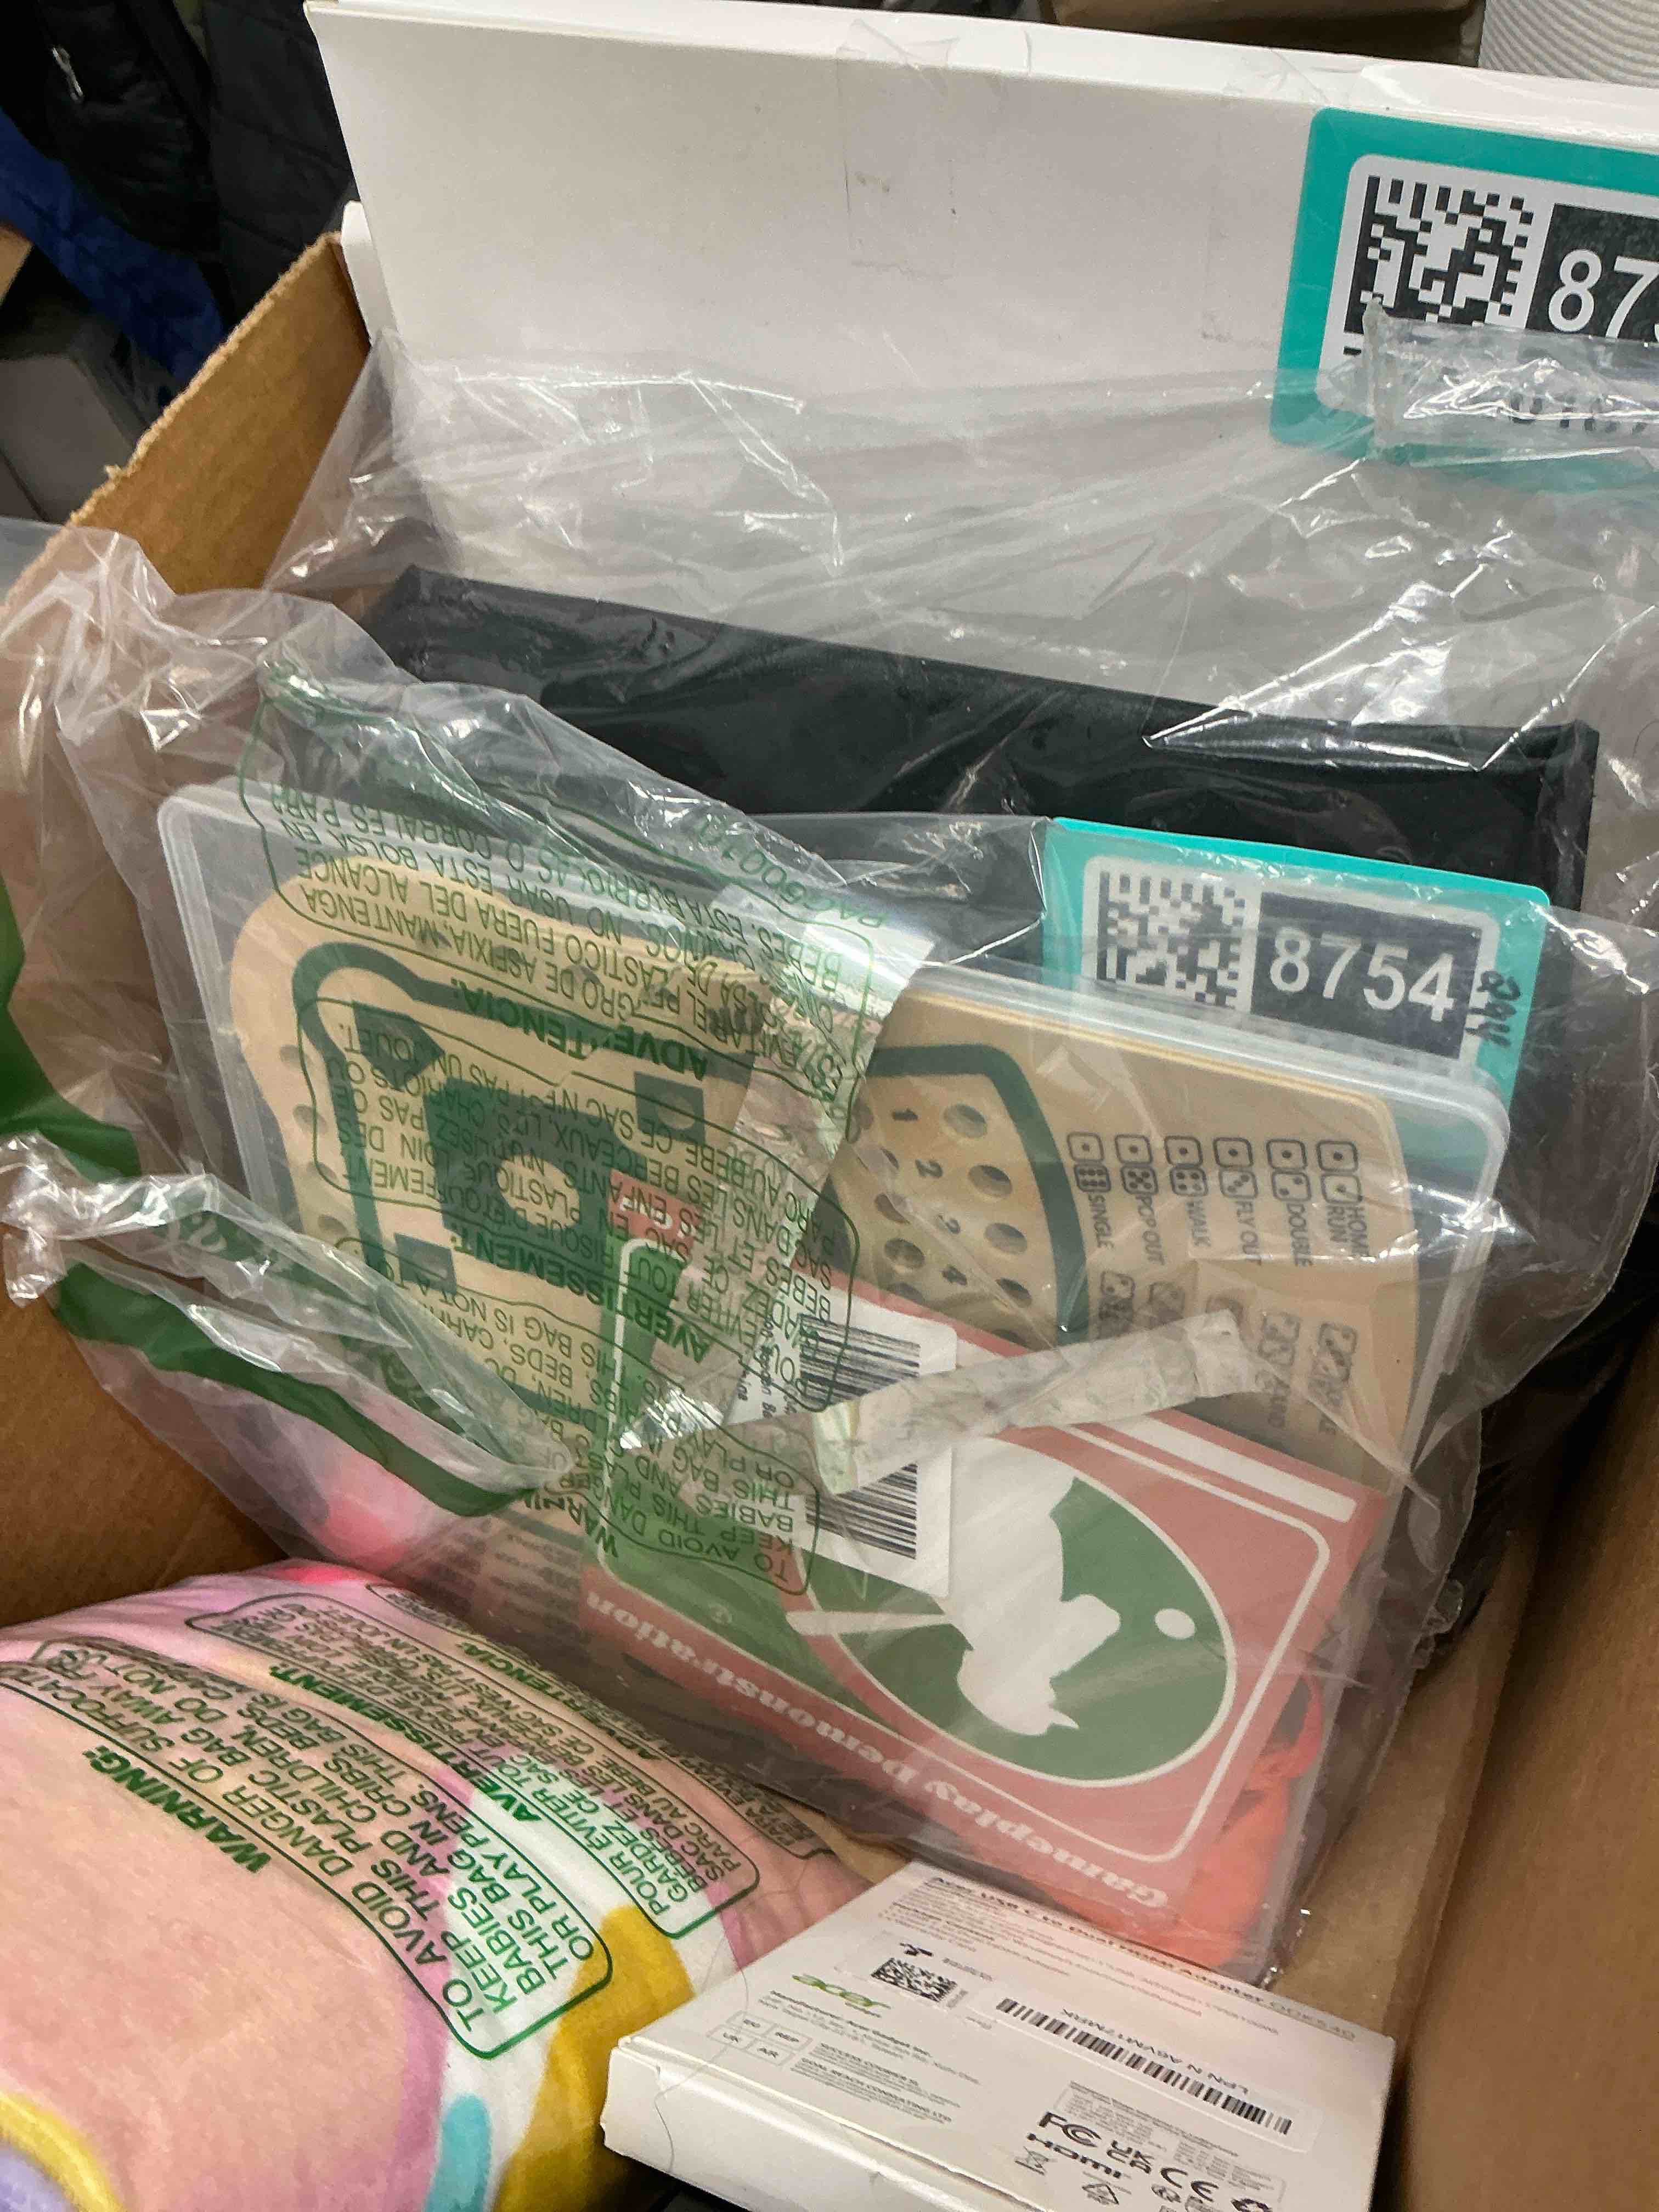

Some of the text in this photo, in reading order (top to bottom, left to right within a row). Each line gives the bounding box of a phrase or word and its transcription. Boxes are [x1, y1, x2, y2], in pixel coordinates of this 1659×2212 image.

[1549, 249, 1659, 341] 87
[350, 804, 492, 860] CORRALES
[280, 819, 621, 944] NO USAR ESTA BOLSA EN
[295, 847, 409, 905] ALCANCE
[300, 884, 439, 949] MANTENGA
[419, 881, 467, 923] DEL
[473, 898, 554, 956] FUERA
[442, 921, 537, 984] ASFIXIA,
[545, 961, 574, 1000] DE
[1269, 927, 1454, 1023] 8754
[686, 990, 707, 1034] EL
[325, 1057, 366, 1087] OU
[434, 1053, 462, 1080] UN
[469, 1063, 510, 1101] PAS
[331, 1084, 368, 1115] CE
[378, 1094, 424, 1131] PAS
[586, 1098, 634, 1141] SAC
[337, 1119, 384, 1154] DES
[548, 1116, 679, 1197] BERCEAUX,
[639, 1118, 673, 1154] CE
[915, 1159, 944, 1178] 2
[463, 1161, 580, 1229] PLASTIQUE
[686, 1175, 728, 1221] LES
[1235, 1200, 1255, 1231] FLY
[534, 1212, 615, 1270] RISQUE
[599, 1207, 629, 1242] EN
[678, 1207, 718, 1250] LES
[732, 1197, 791, 1256] DANS
[1089, 1193, 1114, 1249] SINGLE
[1187, 1200, 1212, 1249] WALK
[1286, 1203, 1313, 1268] DOUBLE
[1327, 1205, 1348, 1243] RUN
[645, 1227, 690, 1266] SAC
[725, 1234, 755, 1273] ET
[1142, 1229, 1165, 1266] OUT
[416, 1276, 430, 1296] A
[623, 1254, 679, 1304] TOUT
[702, 1254, 729, 1294] CE
[439, 1288, 486, 1320] NOT
[450, 1236, 712, 1364] AVERTISSEMENT:
[494, 1308, 515, 1336] IS
[523, 1317, 572, 1359] BAG
[503, 1338, 572, 1388] BEDS,
[634, 1455, 680, 1498] AND
[672, 1447, 720, 1492] BAG
[755, 1462, 795, 1488] OR
[652, 1493, 702, 1536] THIS
[696, 1493, 793, 1533] BABIES
[731, 1480, 795, 1513] THIS
[657, 1529, 741, 1561] AVOID
[720, 1526, 793, 1555] KEEP
[753, 1553, 789, 1583] TO
[586, 1591, 917, 1784] Demonstration
[174, 1697, 228, 1724] DO
[281, 1707, 346, 1745] BAG
[516, 1712, 563, 1738] SAC
[179, 1726, 252, 1768] BAG
[268, 1666, 542, 1823] AVERTISSEMENT:
[339, 1742, 407, 1789] THIS
[565, 1736, 594, 1755] CE
[323, 1752, 412, 1818] CRIBS,
[468, 1748, 531, 1787] TOUT
[509, 1754, 560, 1784] SAC
[582, 1763, 627, 1792] LES
[81, 1744, 272, 1875] WARNING:
[247, 1769, 373, 1855] PLASTIC
[409, 1784, 490, 1849] PENS.
[561, 1790, 600, 1814] CE
[602, 1803, 638, 1824] ET
[624, 1793, 683, 1838] DANS
[651, 1797, 686, 1821] AU
[380, 1830, 450, 1878] AND
[408, 1819, 449, 1847] IN
[684, 1821, 741, 1872] PARC
[923, 1781, 1169, 1909] Gameplay
[446, 1848, 511, 1905] BAG
[481, 1851, 557, 1915] PLAY
[601, 1820, 689, 1903] GARDEZ
[608, 1850, 670, 1916] POUR
[680, 1841, 724, 1882] SAC
[167, 1756, 485, 2034] TO AVOID DANGER OF
[369, 1858, 441, 1922] THIS
[447, 1886, 546, 1995] BABIES
[506, 1908, 568, 1980] THIS
[551, 1914, 595, 1962] OR
[441, 1929, 520, 2013] KEEP
[1160, 2167, 1220, 2202] CE
